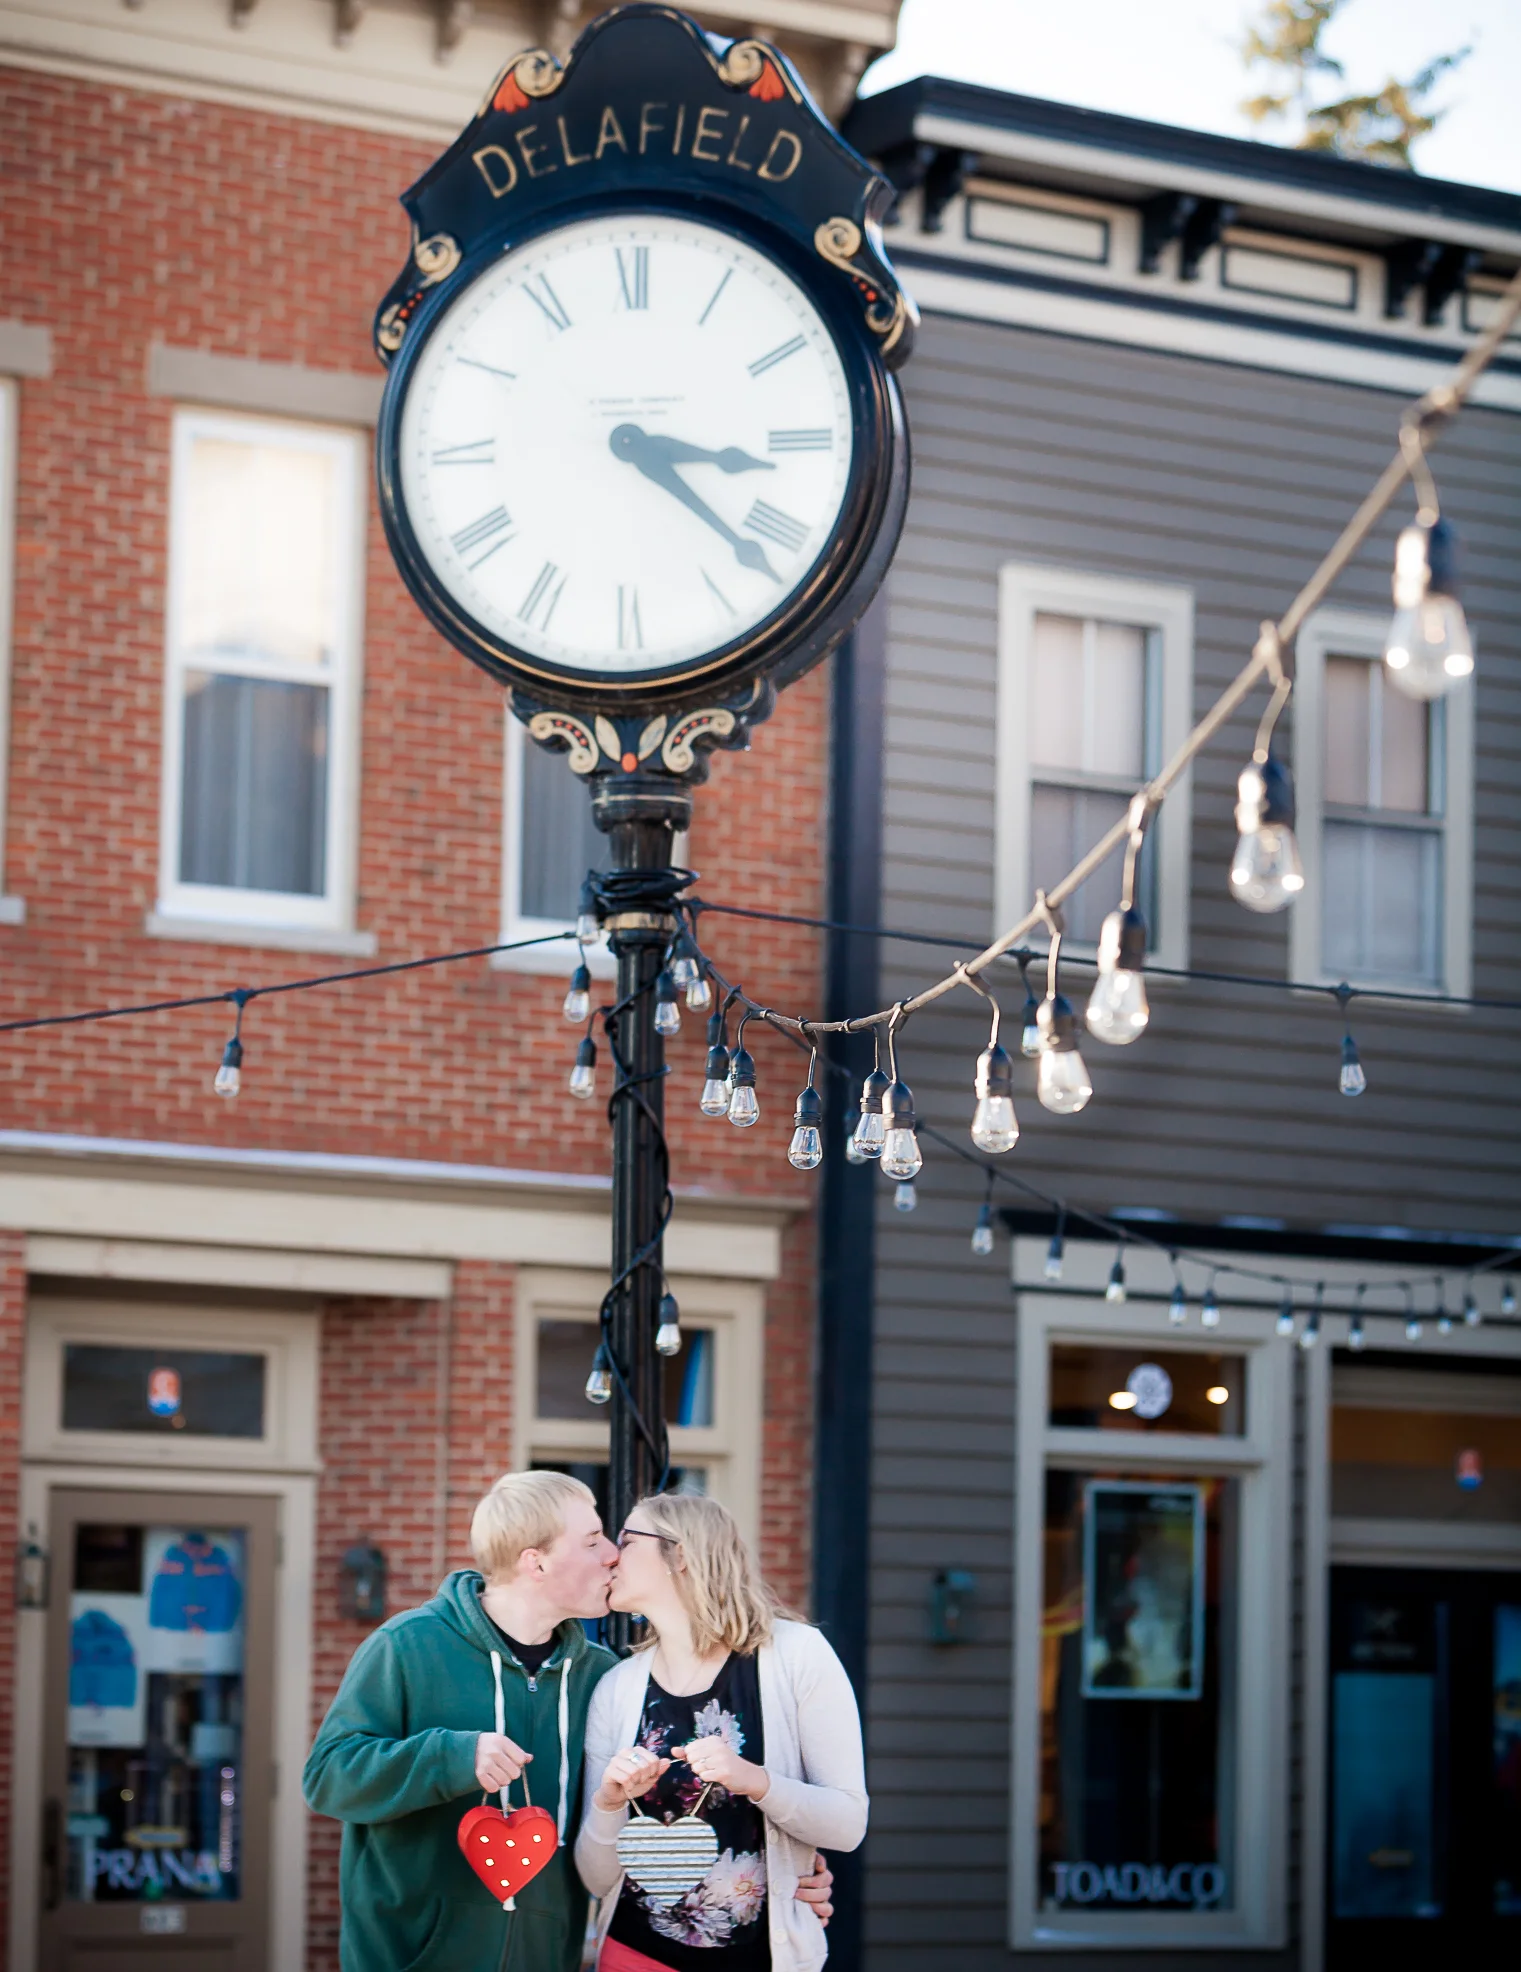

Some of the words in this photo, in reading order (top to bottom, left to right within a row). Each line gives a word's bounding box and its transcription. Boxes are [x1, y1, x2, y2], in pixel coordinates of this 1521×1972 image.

[472, 102, 802, 198] DELAFIELD
[613, 246, 650, 312] XII
[746, 332, 809, 379] II
[768, 426, 833, 453] III
[450, 503, 520, 572] VIII
[742, 497, 813, 554] IIII
[516, 563, 570, 633] VII
[83, 1847, 222, 1894] PRANA
[1049, 1860, 1226, 1903] TOAD&CO
